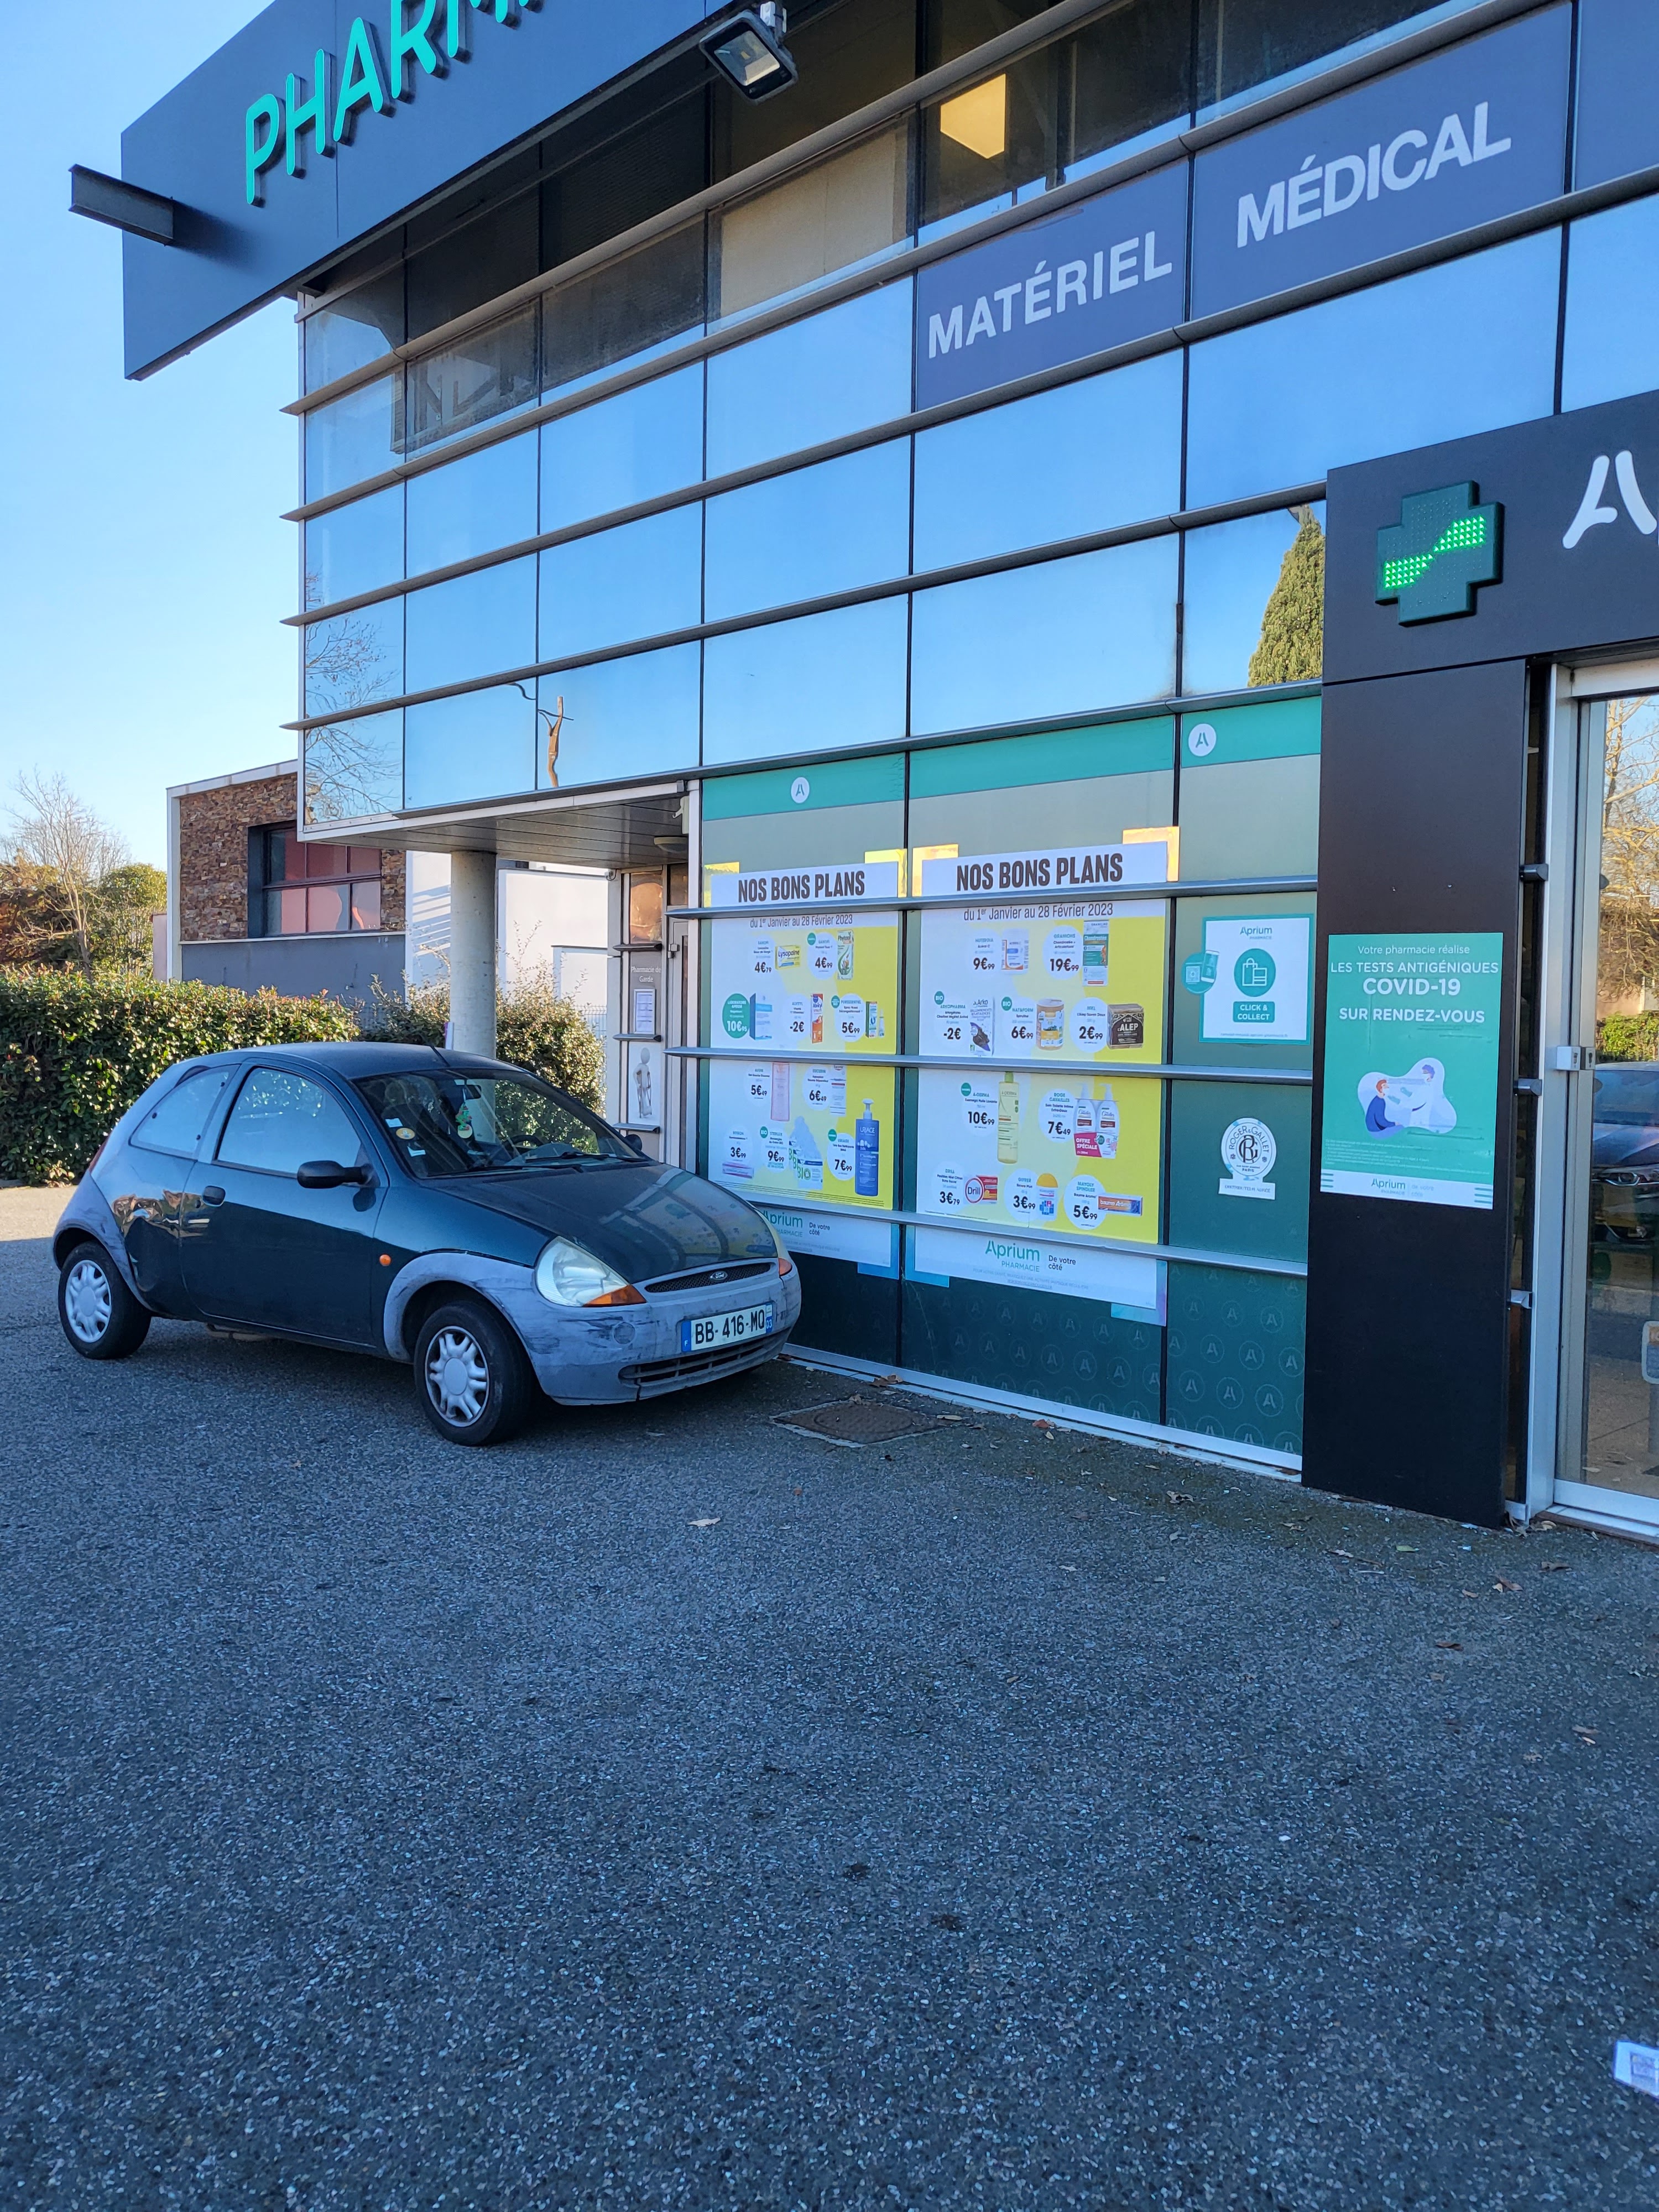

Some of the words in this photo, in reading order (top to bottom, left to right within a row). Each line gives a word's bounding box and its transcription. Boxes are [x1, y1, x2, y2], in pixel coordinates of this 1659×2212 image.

[246, 0, 542, 205] PHAR
[928, 231, 1173, 358] MATÉRIEL
[1236, 101, 1512, 248] MÉDICAL
[1562, 450, 1659, 549] A
[957, 863, 993, 891] NOS
[999, 859, 1050, 888] BONS
[1056, 853, 1123, 884] PLANS
[738, 878, 766, 903] NOS
[771, 874, 810, 900] BONS
[815, 870, 865, 898] PLANS
[964, 908, 974, 921] du
[977, 907, 986, 920] 1er
[989, 906, 1021, 920] Janvier
[1025, 909, 1035, 919] au
[1038, 906, 1050, 918] 28
[1053, 902, 1085, 918] Février
[1088, 903, 1113, 916] 2023
[750, 919, 758, 928] du
[768, 916, 791, 927] Janvier
[802, 916, 810, 926] 28
[811, 914, 834, 926] Février
[836, 914, 853, 925] 2023
[1240, 927, 1272, 936] Aprium
[1358, 946, 1383, 954] Votre
[1385, 945, 1435, 956] pharmacie
[1438, 945, 1470, 954] réalise
[1331, 962, 1352, 973] LES
[1357, 962, 1394, 973] TESTS
[1397, 960, 1499, 973] ANTIGÉNIQUES
[1363, 978, 1460, 995] COVID-19
[1339, 1008, 1368, 1020] SUR
[1373, 1009, 1485, 1023] RENDEZ-VOUS
[790, 1021, 805, 1032] -2€
[943, 1027, 961, 1040] -2€
[968, 1112, 994, 1125] 10€99
[1229, 1126, 1248, 1150] ROGER
[1251, 1126, 1270, 1153] GALLET
[968, 1187, 980, 1195] Drill
[1371, 1178, 1406, 1190] Aprium
[940, 1191, 959, 1205] 3€79
[1013, 1195, 1035, 1209] 3€99
[1073, 1205, 1097, 1220] 5€99
[776, 1229, 802, 1237] HARMACIE
[985, 1240, 1040, 1262] Aprium
[1001, 1261, 1040, 1272] PHARMACIE
[766, 1319, 773, 1328] 03
